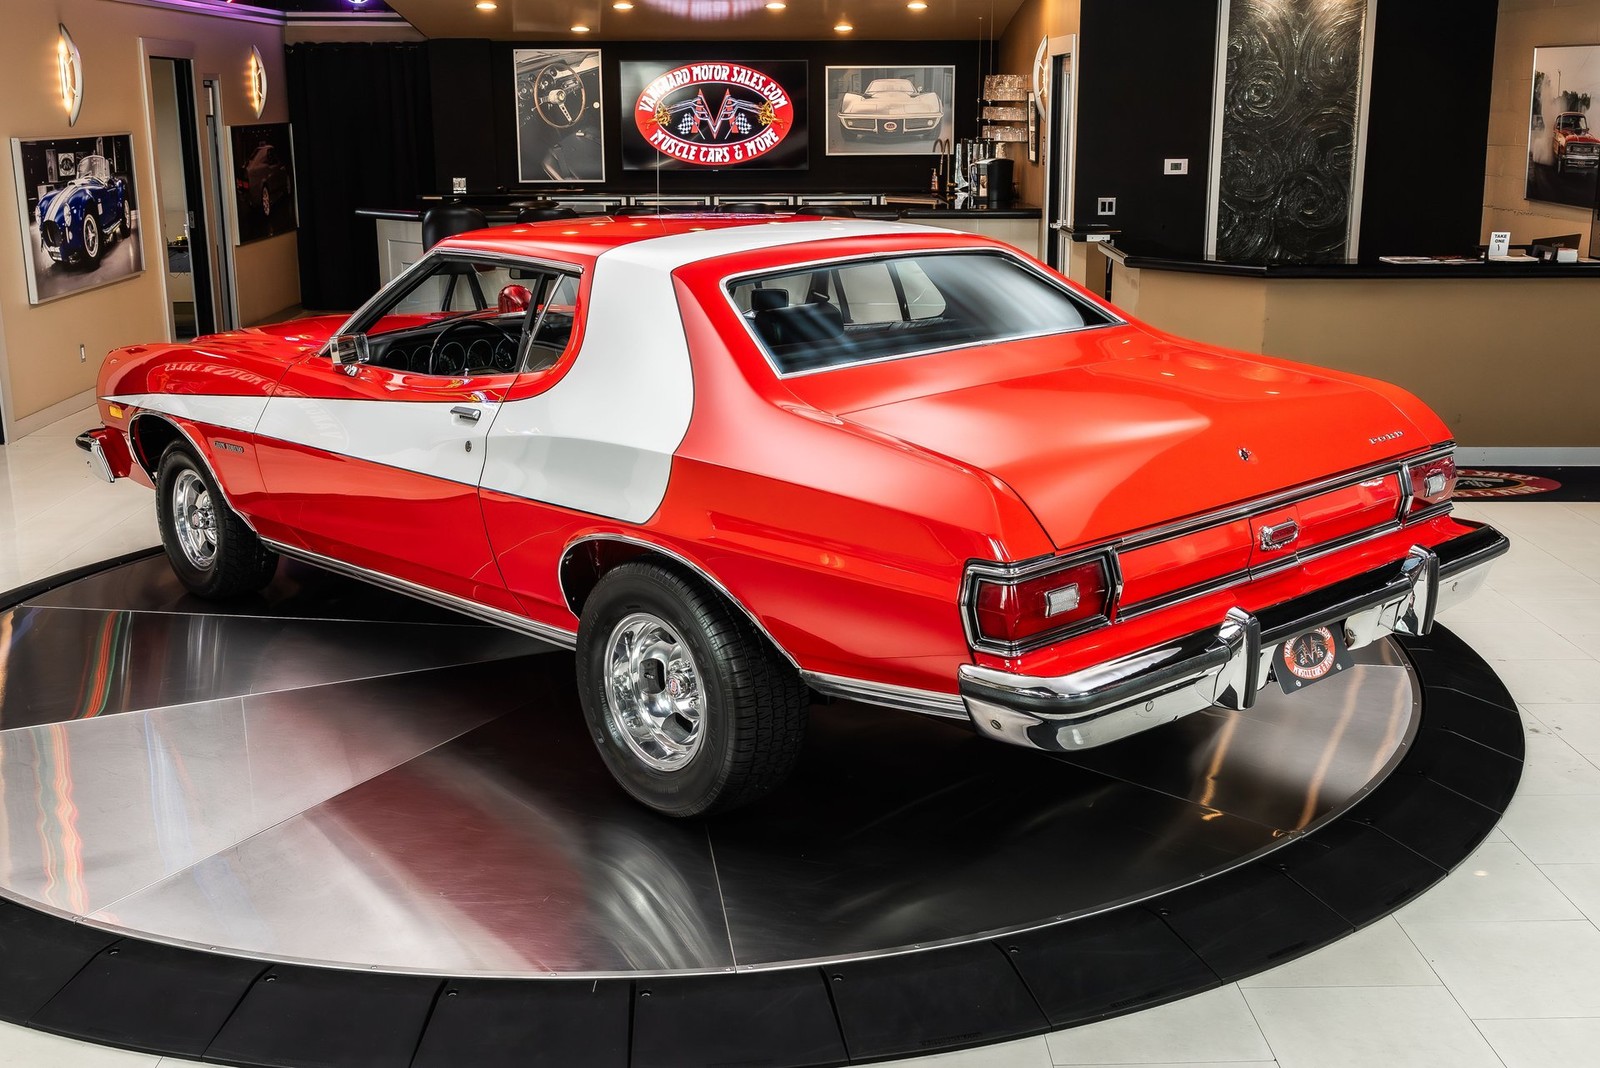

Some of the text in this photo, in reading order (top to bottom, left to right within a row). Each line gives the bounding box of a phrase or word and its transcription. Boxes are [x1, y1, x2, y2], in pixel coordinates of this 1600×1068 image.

[639, 64, 788, 112] VANGUARD MOTOR SALES.COM
[650, 128, 780, 163] MUSCLE CARS & MORE
